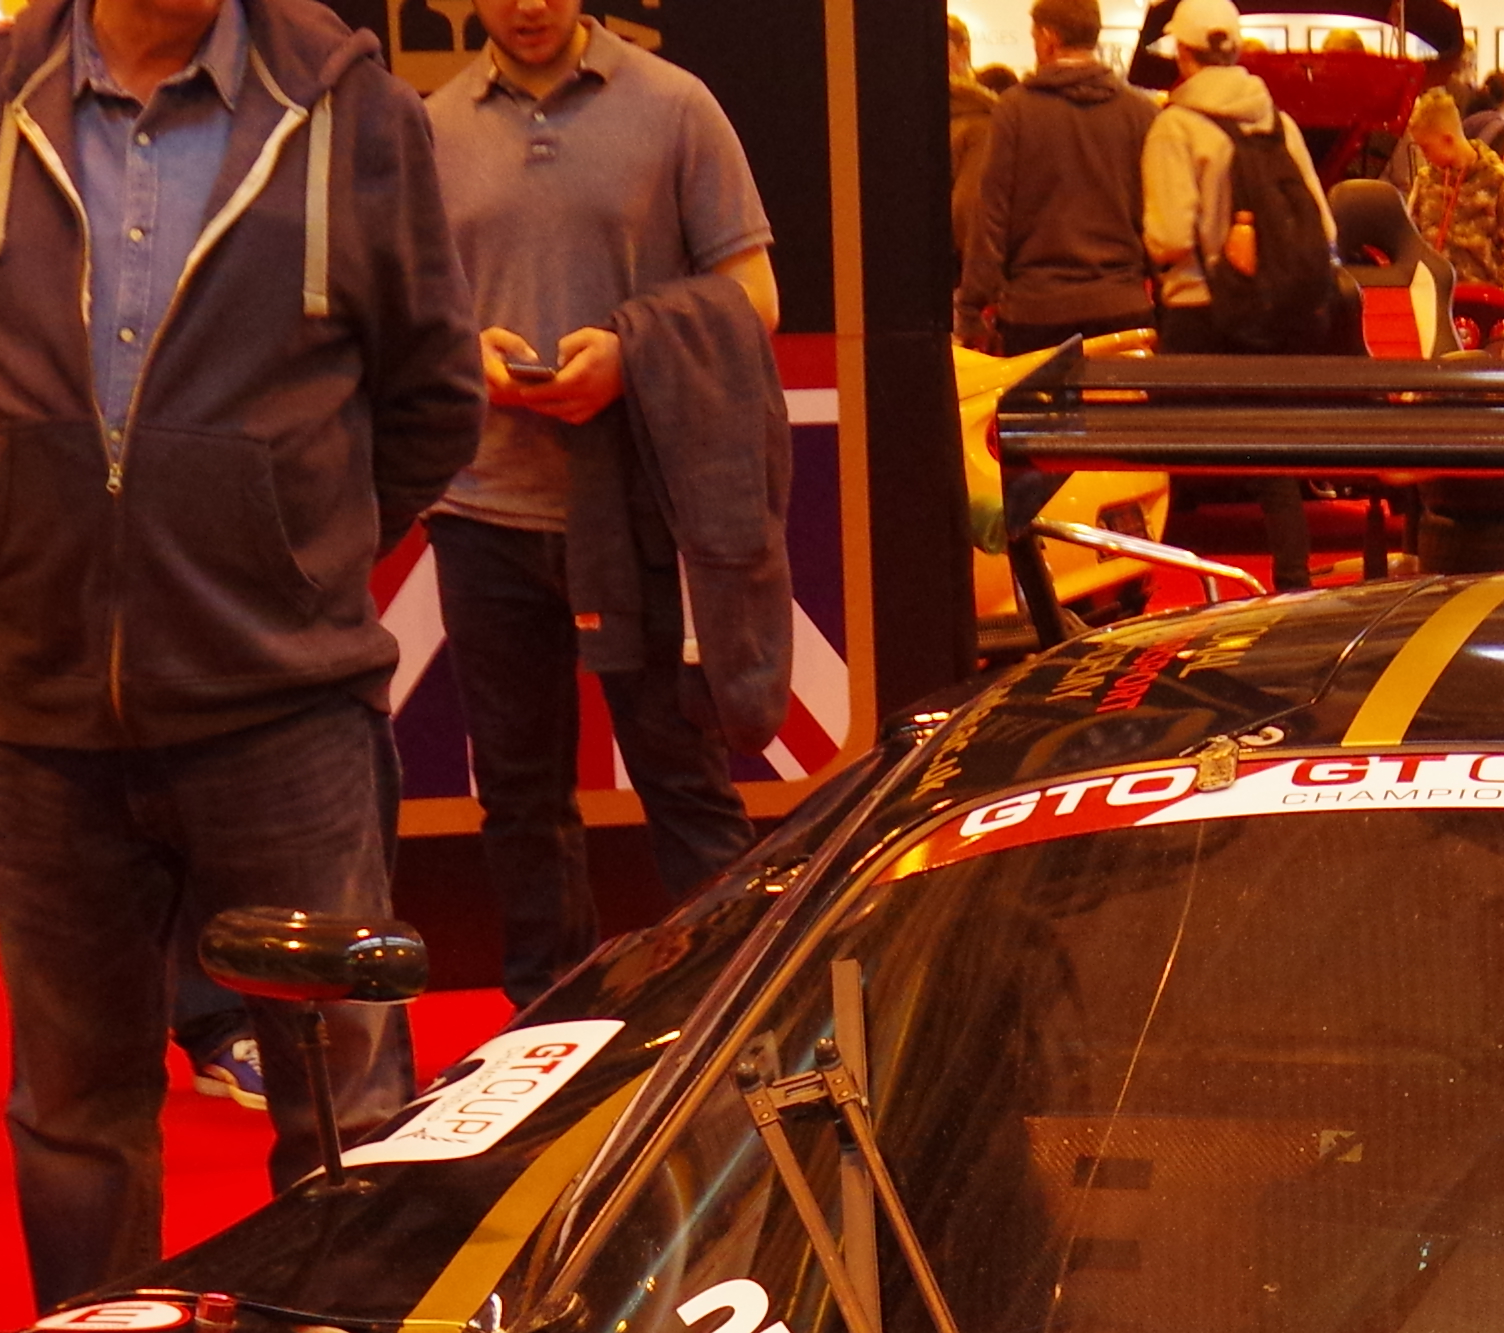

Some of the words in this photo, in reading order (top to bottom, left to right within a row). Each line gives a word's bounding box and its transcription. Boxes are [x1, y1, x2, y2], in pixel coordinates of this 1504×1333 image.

[1291, 754, 1447, 788] GT
[959, 766, 1198, 838] GTO
[509, 1042, 579, 1075] GT
[445, 1078, 539, 1135] CUP
